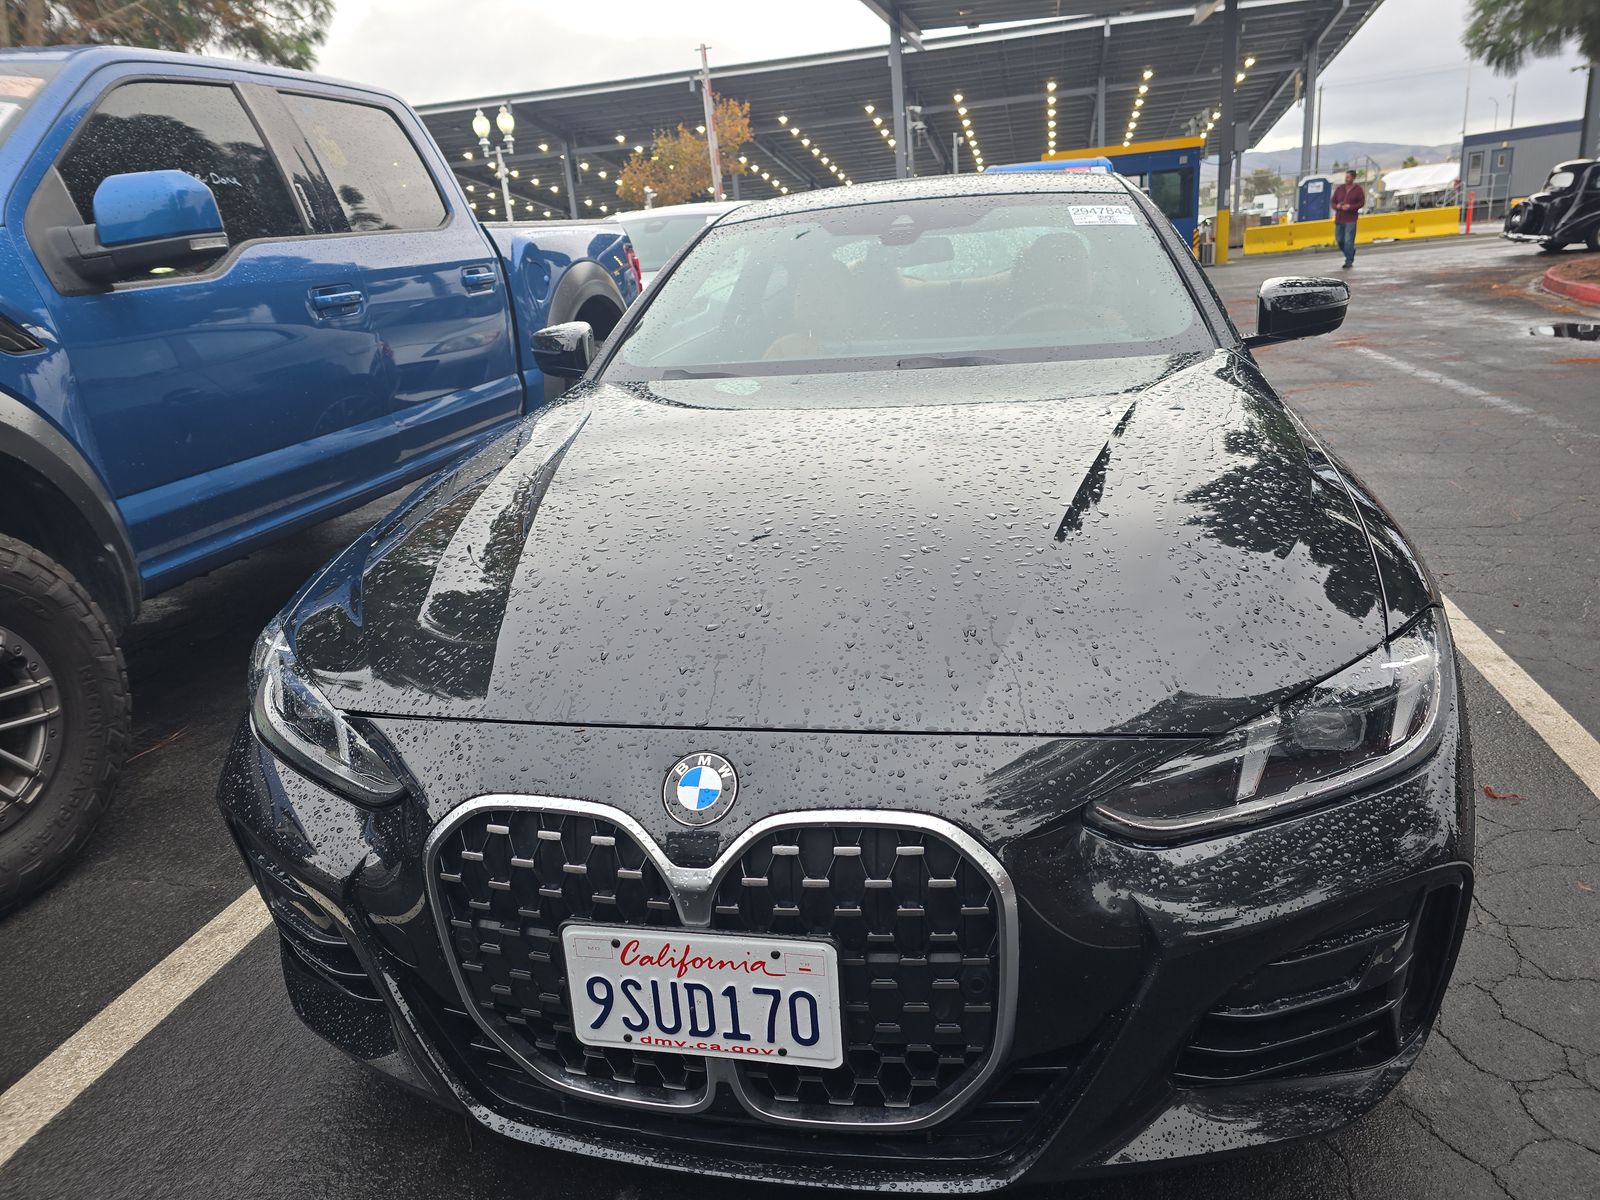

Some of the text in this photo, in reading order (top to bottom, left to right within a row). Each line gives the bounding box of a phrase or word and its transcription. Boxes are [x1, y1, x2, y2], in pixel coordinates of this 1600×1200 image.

[674, 755, 733, 779] BMW
[620, 939, 786, 979] California
[586, 976, 819, 1046] 9SUD170
[640, 1036, 774, 1056] dmv.ca.gov
